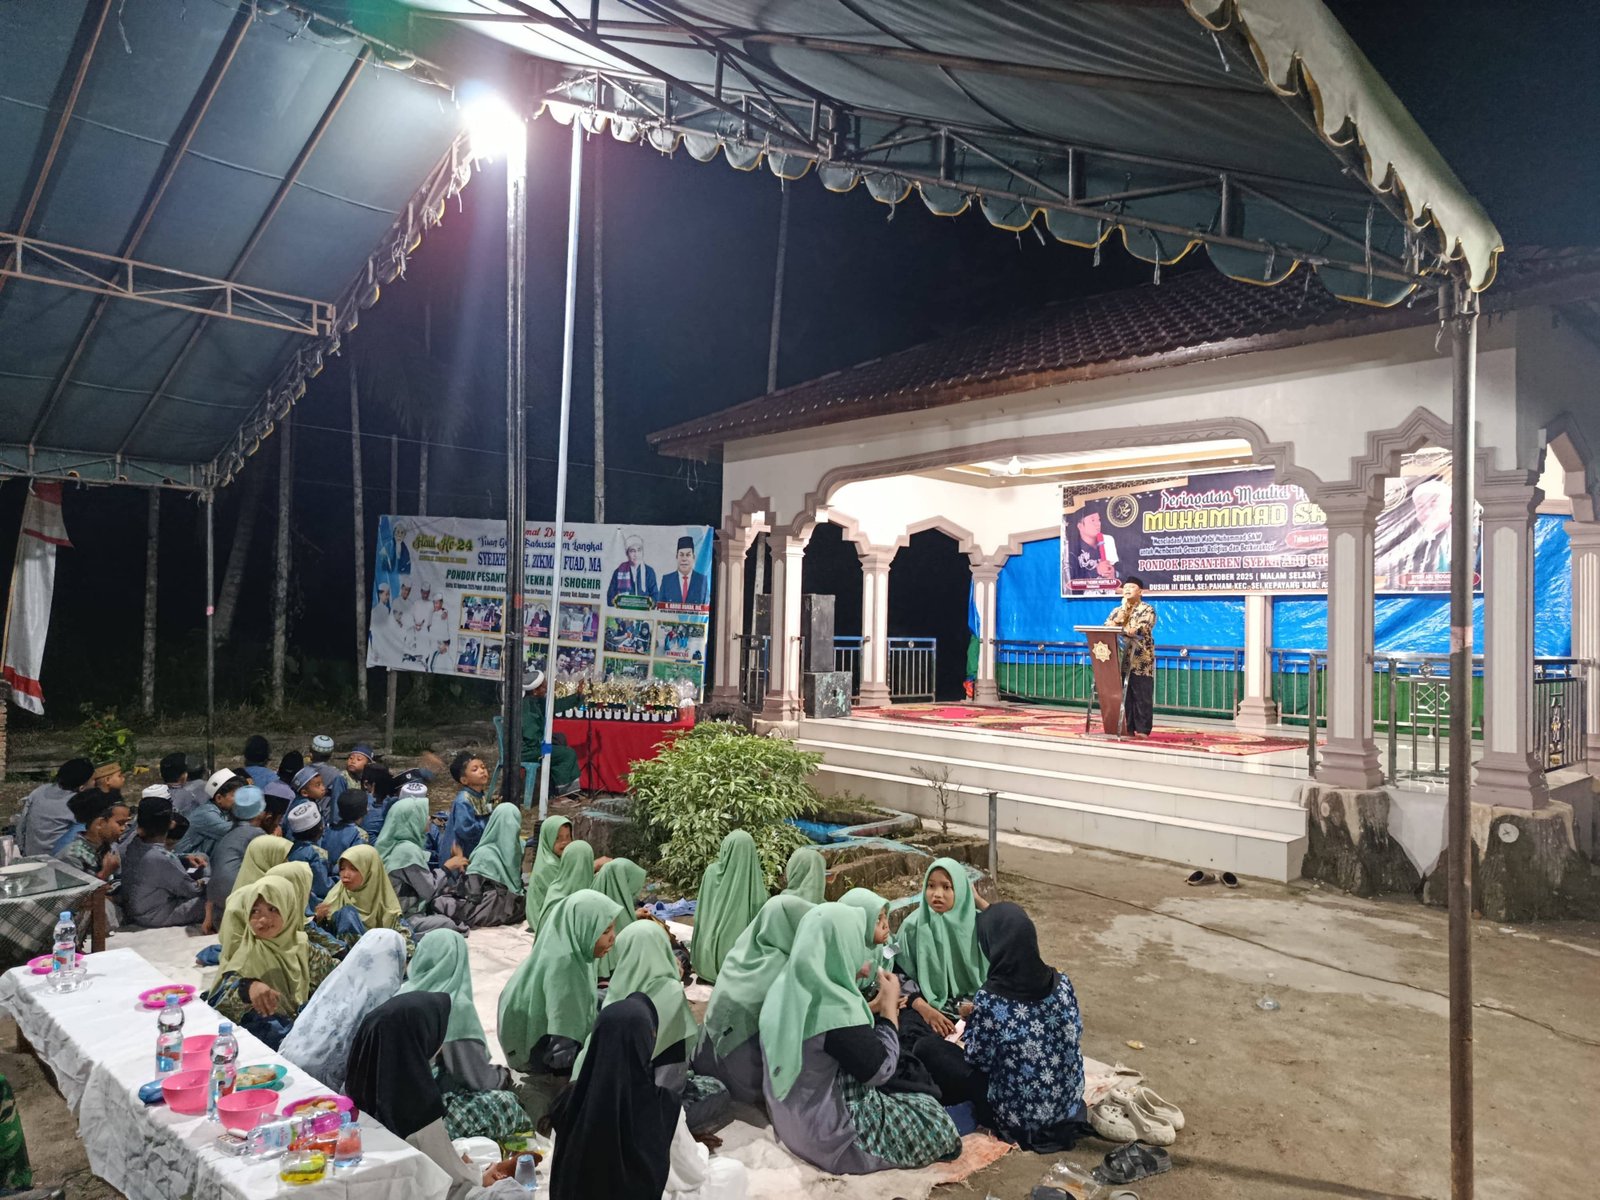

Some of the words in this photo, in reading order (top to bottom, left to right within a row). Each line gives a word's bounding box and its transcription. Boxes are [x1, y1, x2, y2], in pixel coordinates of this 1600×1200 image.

[1160, 489, 1232, 511] Peringatan
[1234, 485, 1290, 504] Maulid
[1143, 503, 1288, 533] MUHAMMAD
[524, 538, 570, 550] Babussam
[1138, 559, 1180, 571] PONDOK
[1180, 556, 1241, 570] PESANTREN
[446, 569, 476, 581] PONDOK
[564, 576, 601, 590] SHOGHIR
[1204, 573, 1234, 581] OKTOBER
[1236, 572, 1253, 580] 2025
[1260, 572, 1287, 580] MALAM
[1288, 571, 1316, 579] SELASA
[1209, 582, 1232, 590] PAHAM
[1264, 581, 1300, 589] KEPAYANG
